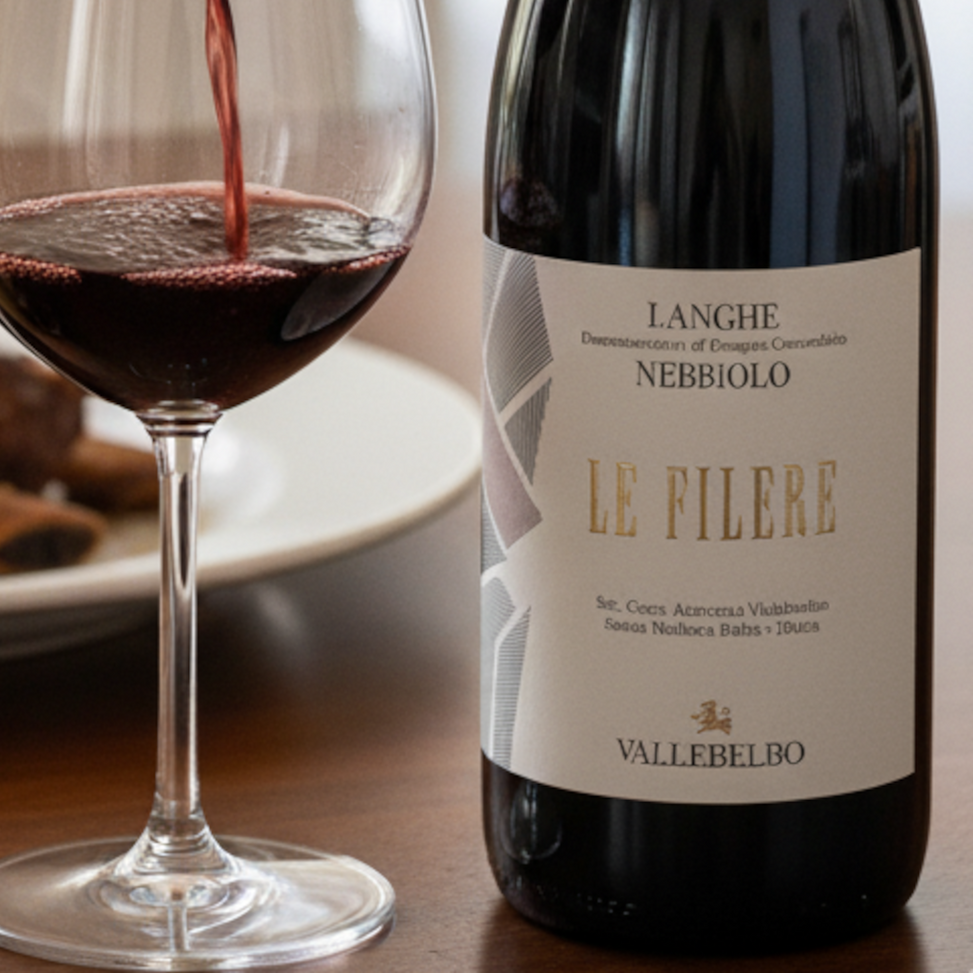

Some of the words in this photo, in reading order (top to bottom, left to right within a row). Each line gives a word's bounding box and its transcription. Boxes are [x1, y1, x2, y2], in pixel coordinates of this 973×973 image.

[647, 302, 780, 330] LANGHE
[588, 458, 637, 536] LE
[666, 460, 836, 541] FILERE
[617, 739, 806, 767] VALLEBELBO
